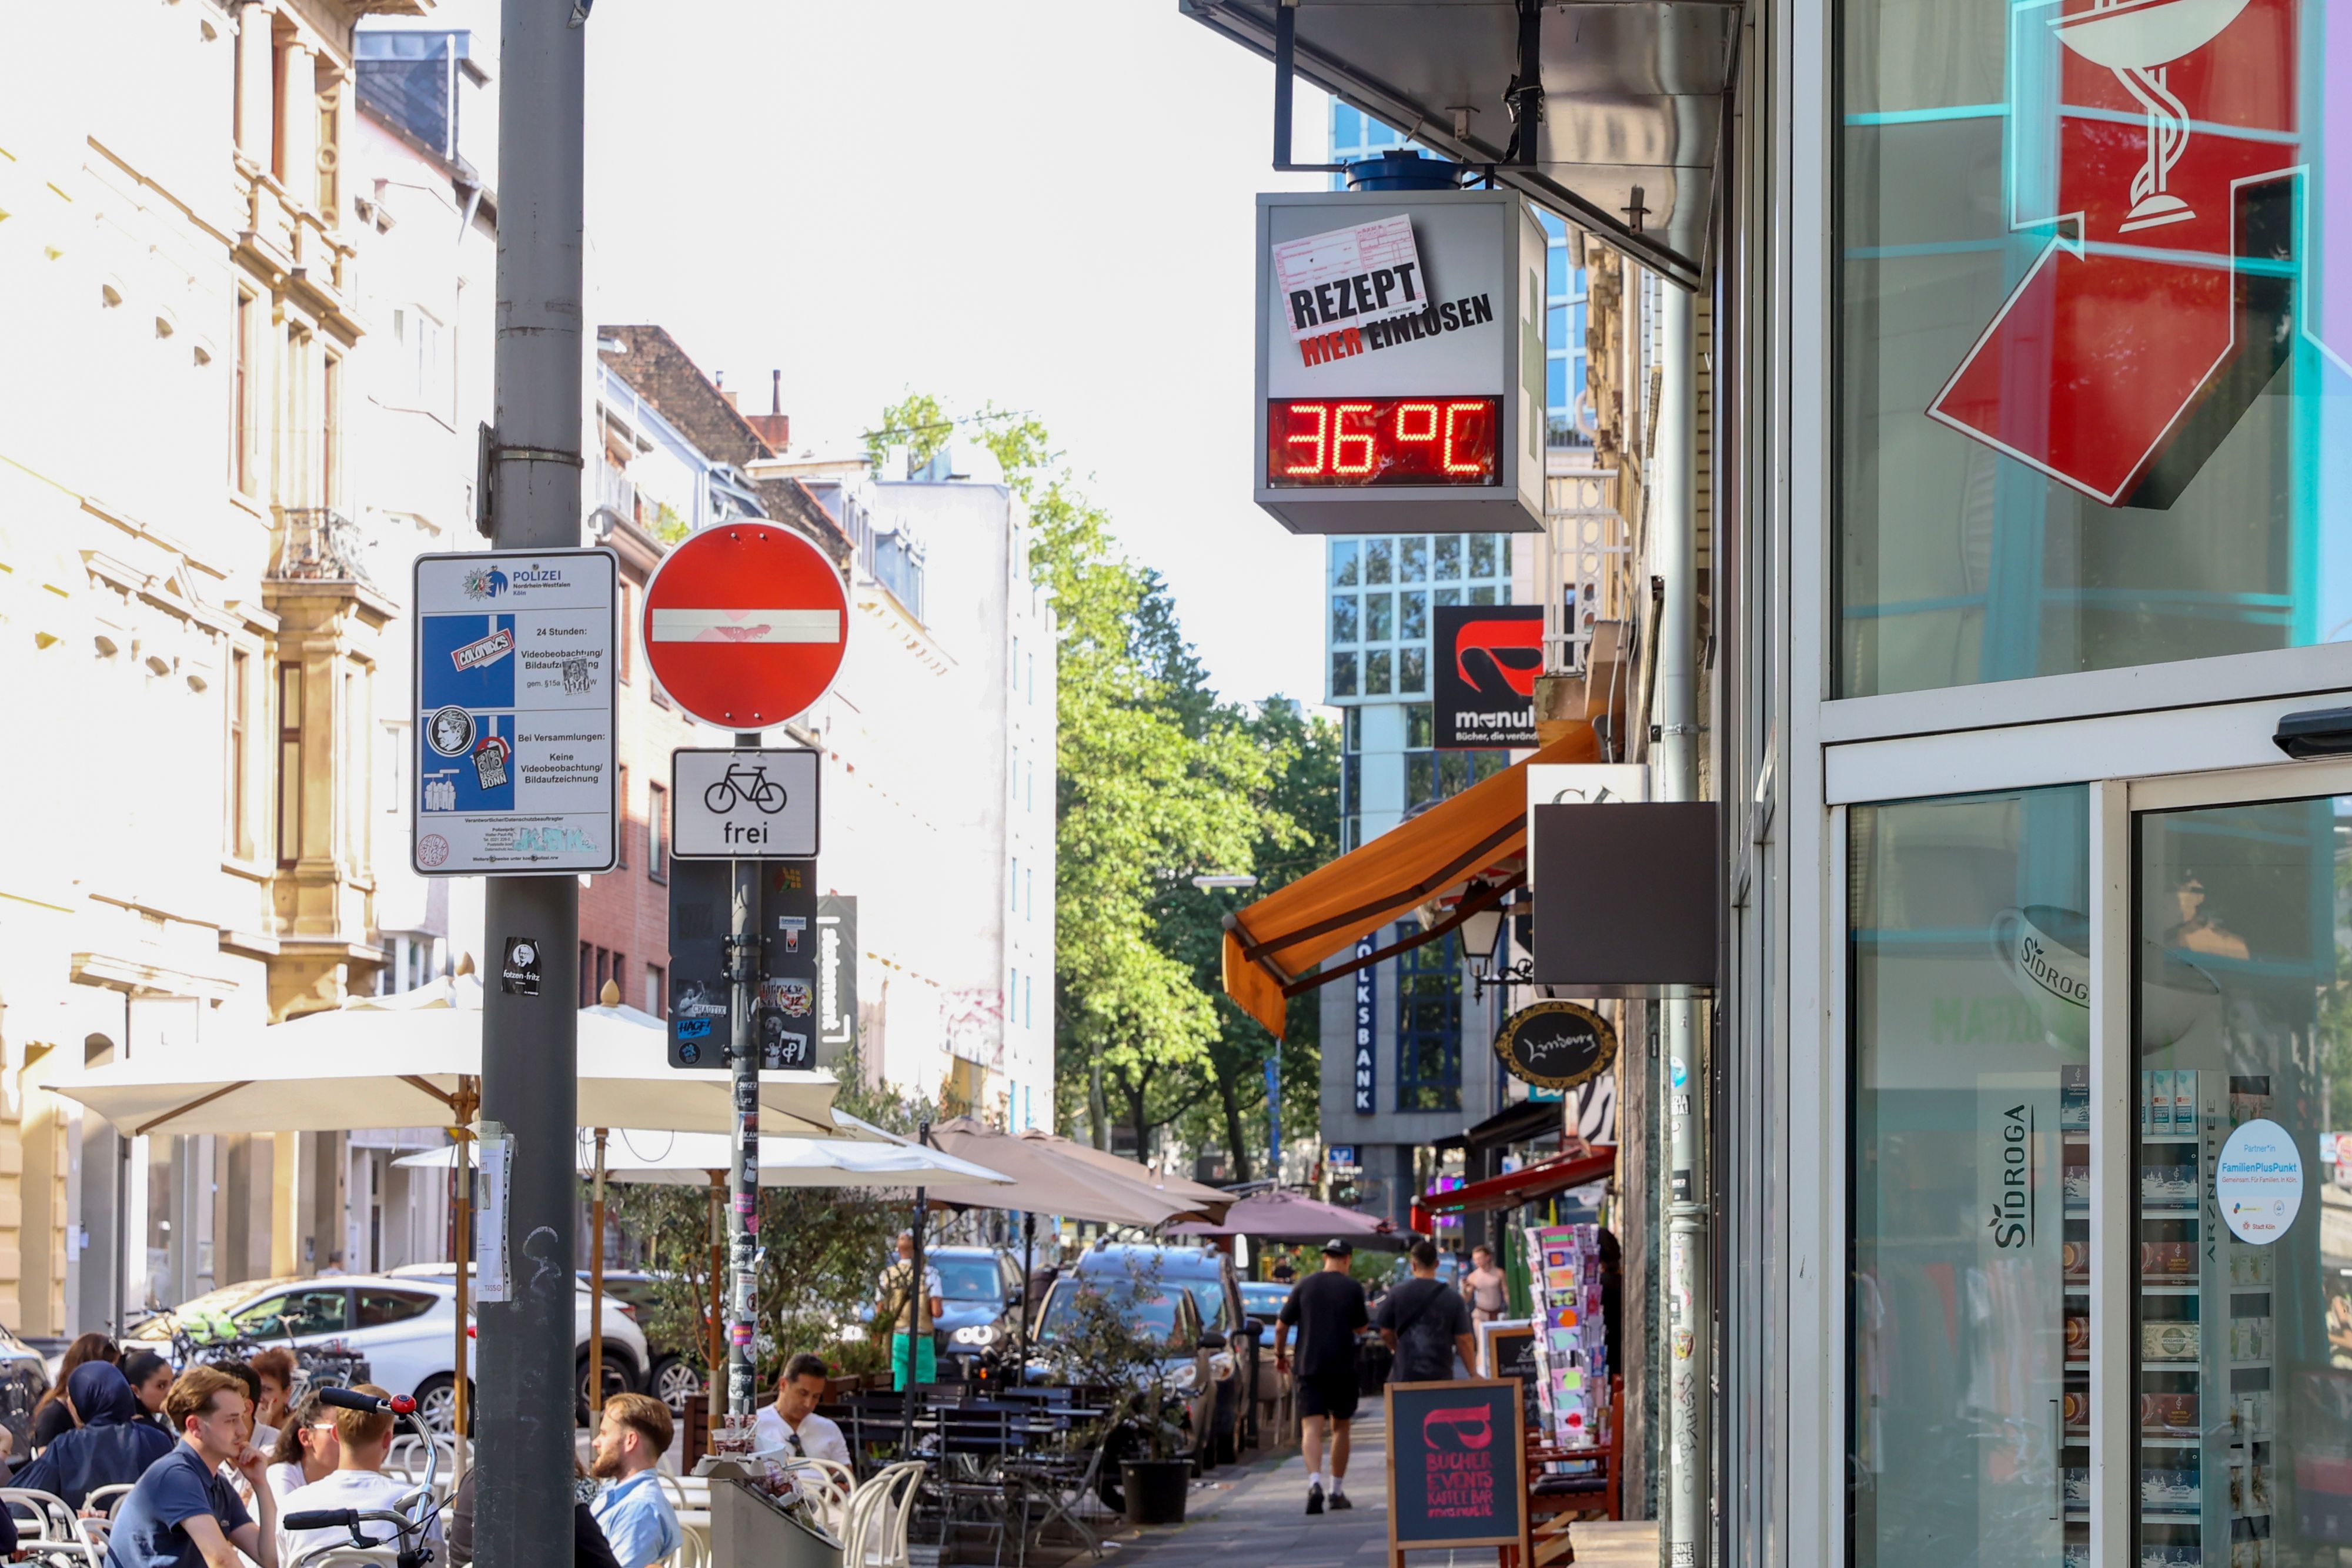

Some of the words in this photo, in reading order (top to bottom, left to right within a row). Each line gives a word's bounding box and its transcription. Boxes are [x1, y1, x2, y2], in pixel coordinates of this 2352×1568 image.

[1289, 262, 1416, 330] REZEPT
[1299, 327, 1364, 367] HIER
[1367, 293, 1494, 351] EINLÖSEN
[1287, 404, 1374, 474] 36
[513, 570, 561, 581] POLIZEI
[537, 628, 546, 636] 24
[549, 627, 587, 636] Stunden:
[459, 634, 510, 667] COLONIACS
[525, 660, 599, 670] Bildaufzng
[544, 680, 560, 688] §15a
[1455, 705, 1535, 728] manul
[518, 734, 532, 743] Bei
[534, 733, 606, 743] Versammlungen:
[1455, 731, 1489, 742] Bücher,
[1491, 732, 1505, 740] die
[1506, 732, 1538, 740] veränd
[550, 753, 574, 761] Keine
[521, 763, 603, 774] Videobeobachtung/
[482, 774, 507, 789] BONN
[525, 775, 599, 785] Bildaufzeichnung
[724, 821, 769, 844] frei
[2021, 935, 2090, 1002] SIDROG
[2222, 1162, 2297, 1172] FamilienPlusPunkt
[1994, 1104, 2026, 1249] SIDROGA
[2207, 1099, 2216, 1263] ARZNEITEE
[1426, 1450, 1493, 1471] BÜCHER
[1426, 1470, 1494, 1490] EVENTS
[1427, 1490, 1468, 1506] KAFFEE
[1471, 1489, 1494, 1505] BAR
